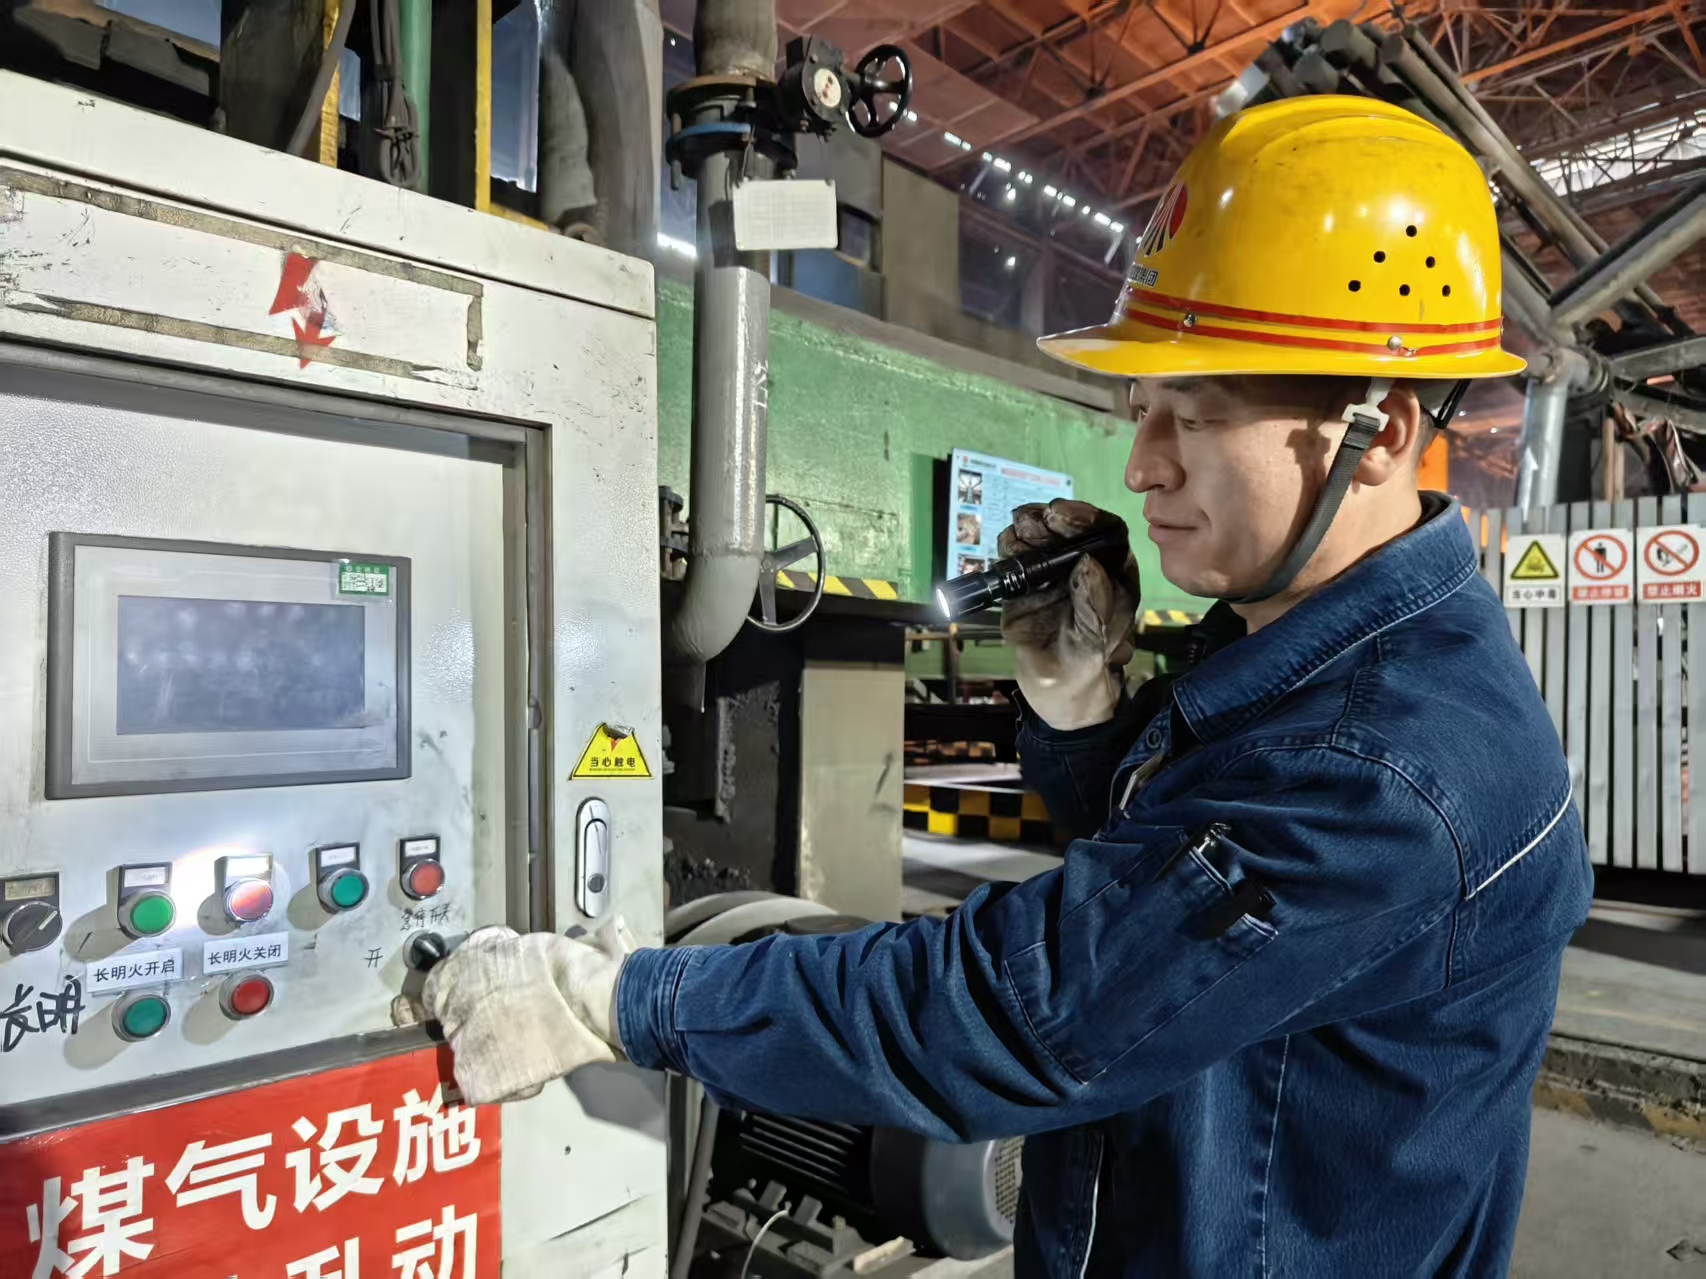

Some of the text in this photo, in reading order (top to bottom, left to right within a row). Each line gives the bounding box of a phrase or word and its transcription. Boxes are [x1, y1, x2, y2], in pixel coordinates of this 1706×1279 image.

[590, 757, 636, 768] 当心触电
[208, 944, 281, 965] 长明火关闭
[94, 959, 175, 982] 长明火开启
[26, 1082, 482, 1279] 煤气设施
